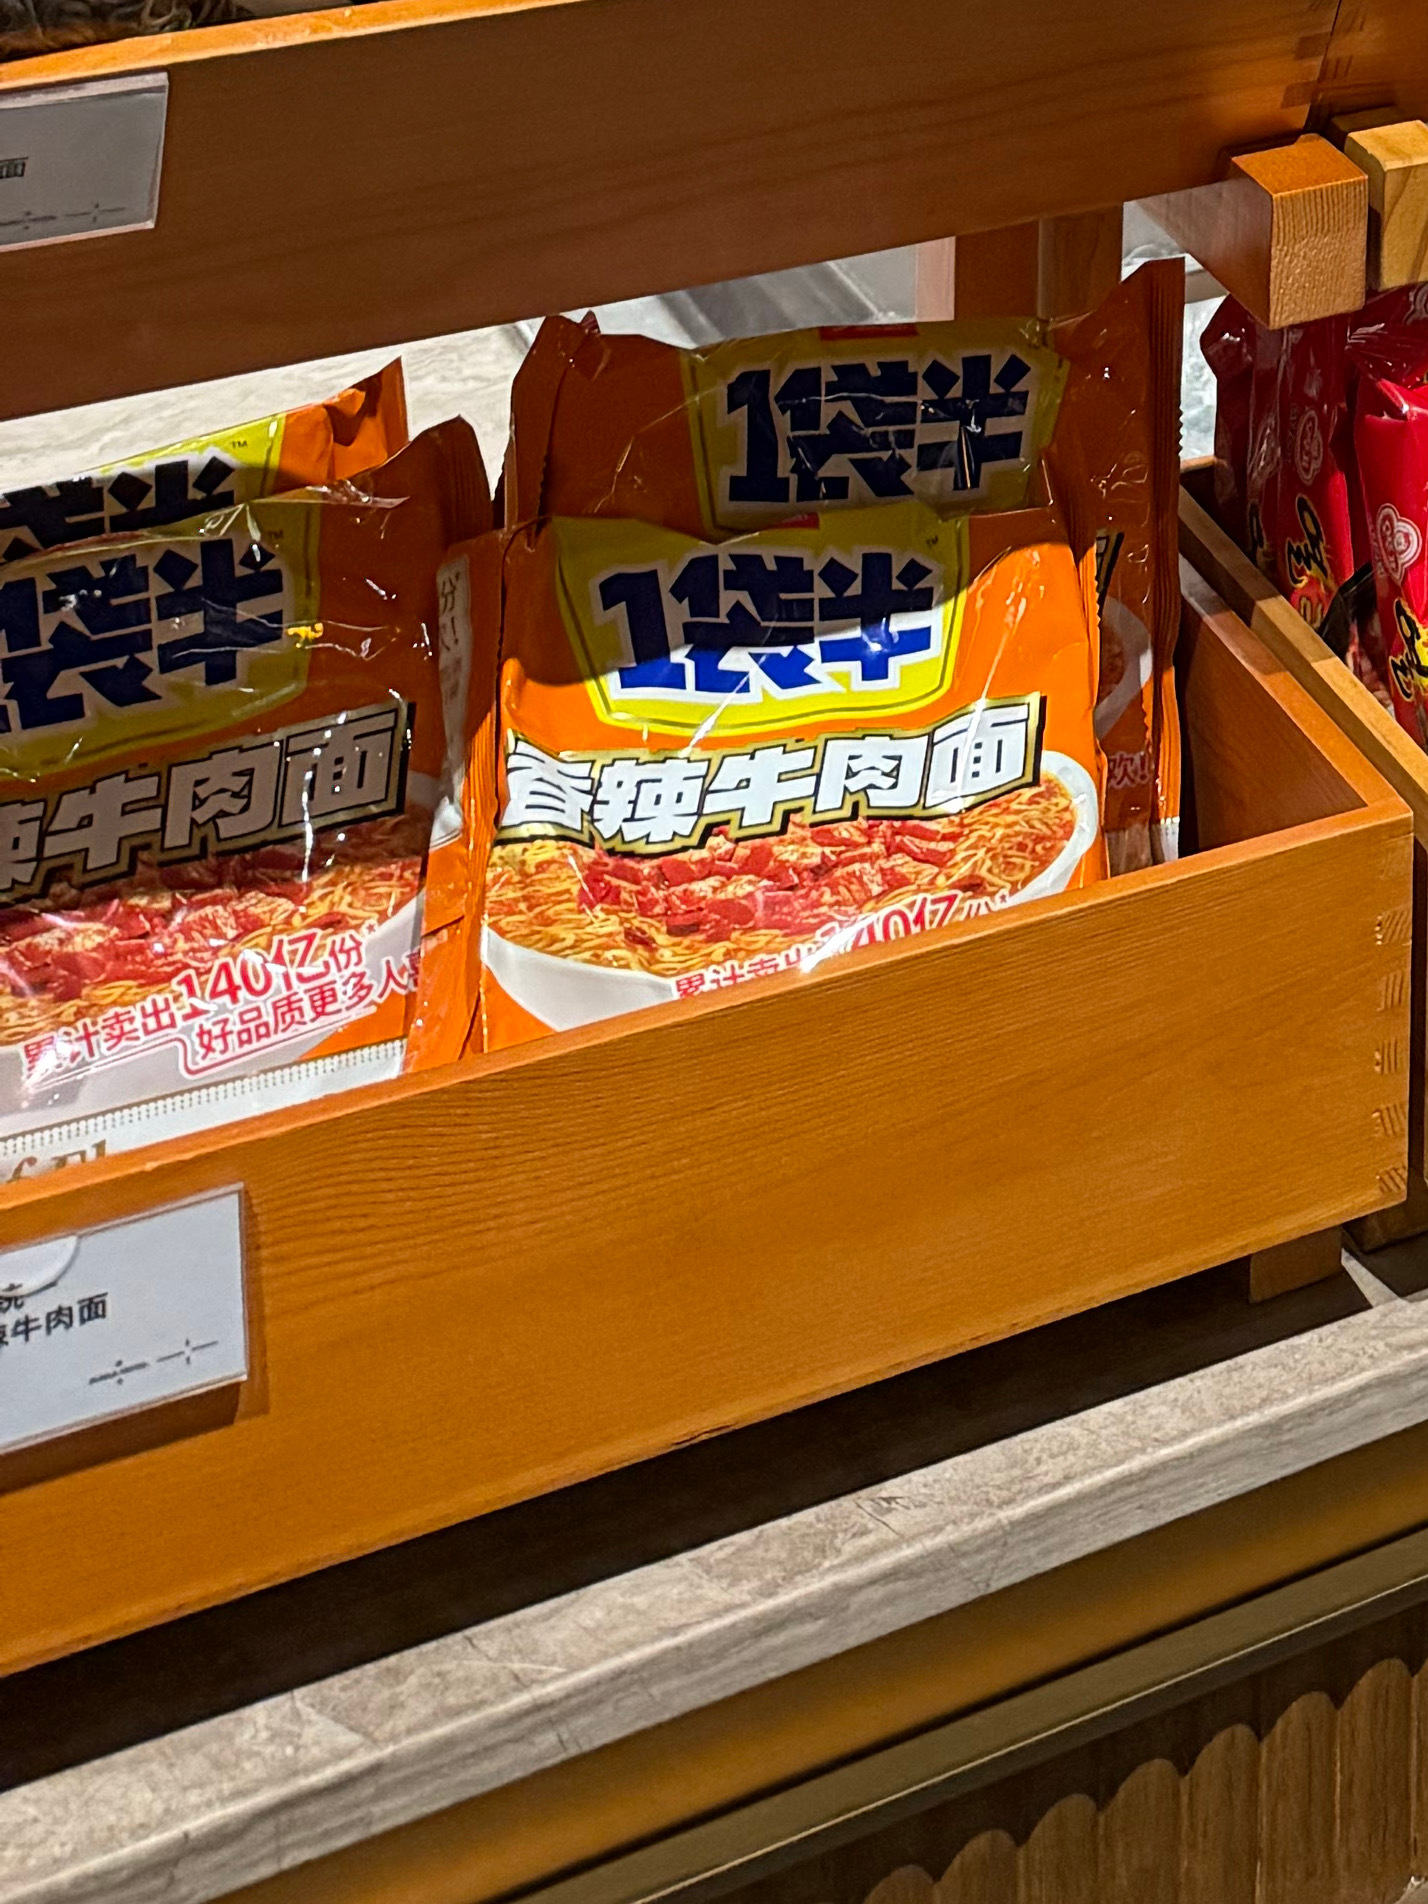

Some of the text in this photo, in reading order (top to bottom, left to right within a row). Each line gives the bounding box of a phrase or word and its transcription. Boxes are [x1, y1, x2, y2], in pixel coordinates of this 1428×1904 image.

[726, 354, 1030, 503] 1袋半
[600, 553, 934, 694] 1袋半
[508, 702, 1030, 843] 香辣牛肉面
